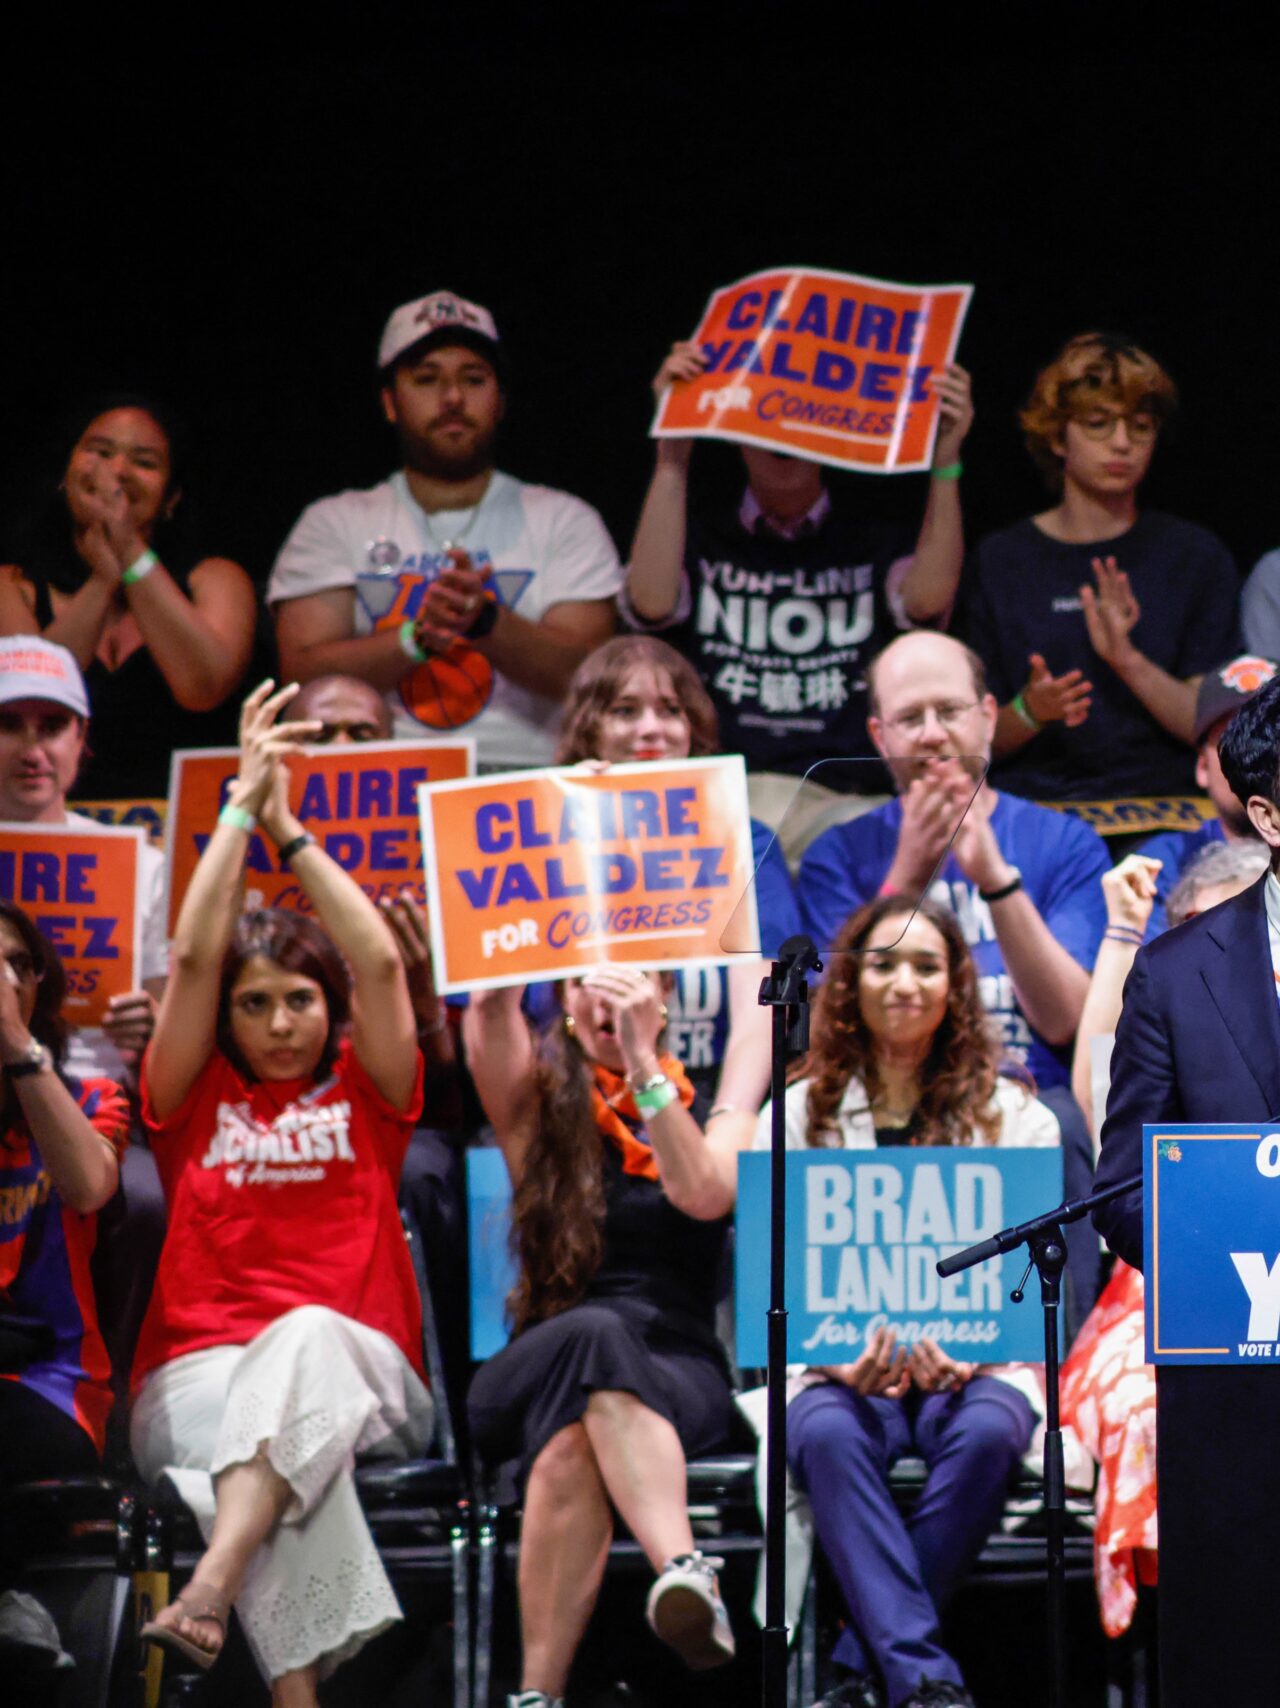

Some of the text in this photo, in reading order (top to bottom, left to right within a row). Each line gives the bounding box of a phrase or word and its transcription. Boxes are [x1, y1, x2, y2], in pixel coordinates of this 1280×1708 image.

[697, 583, 874, 655] NIOU
[475, 787, 699, 854] CLAIRE
[456, 848, 729, 909] VALDEZ
[481, 900, 712, 959] FOR CONGRESS
[806, 1163, 1003, 1244] BRAD
[806, 1245, 1003, 1313] LANDER
[802, 1315, 861, 1350] for
[1238, 1343, 1271, 1357] VOTE
